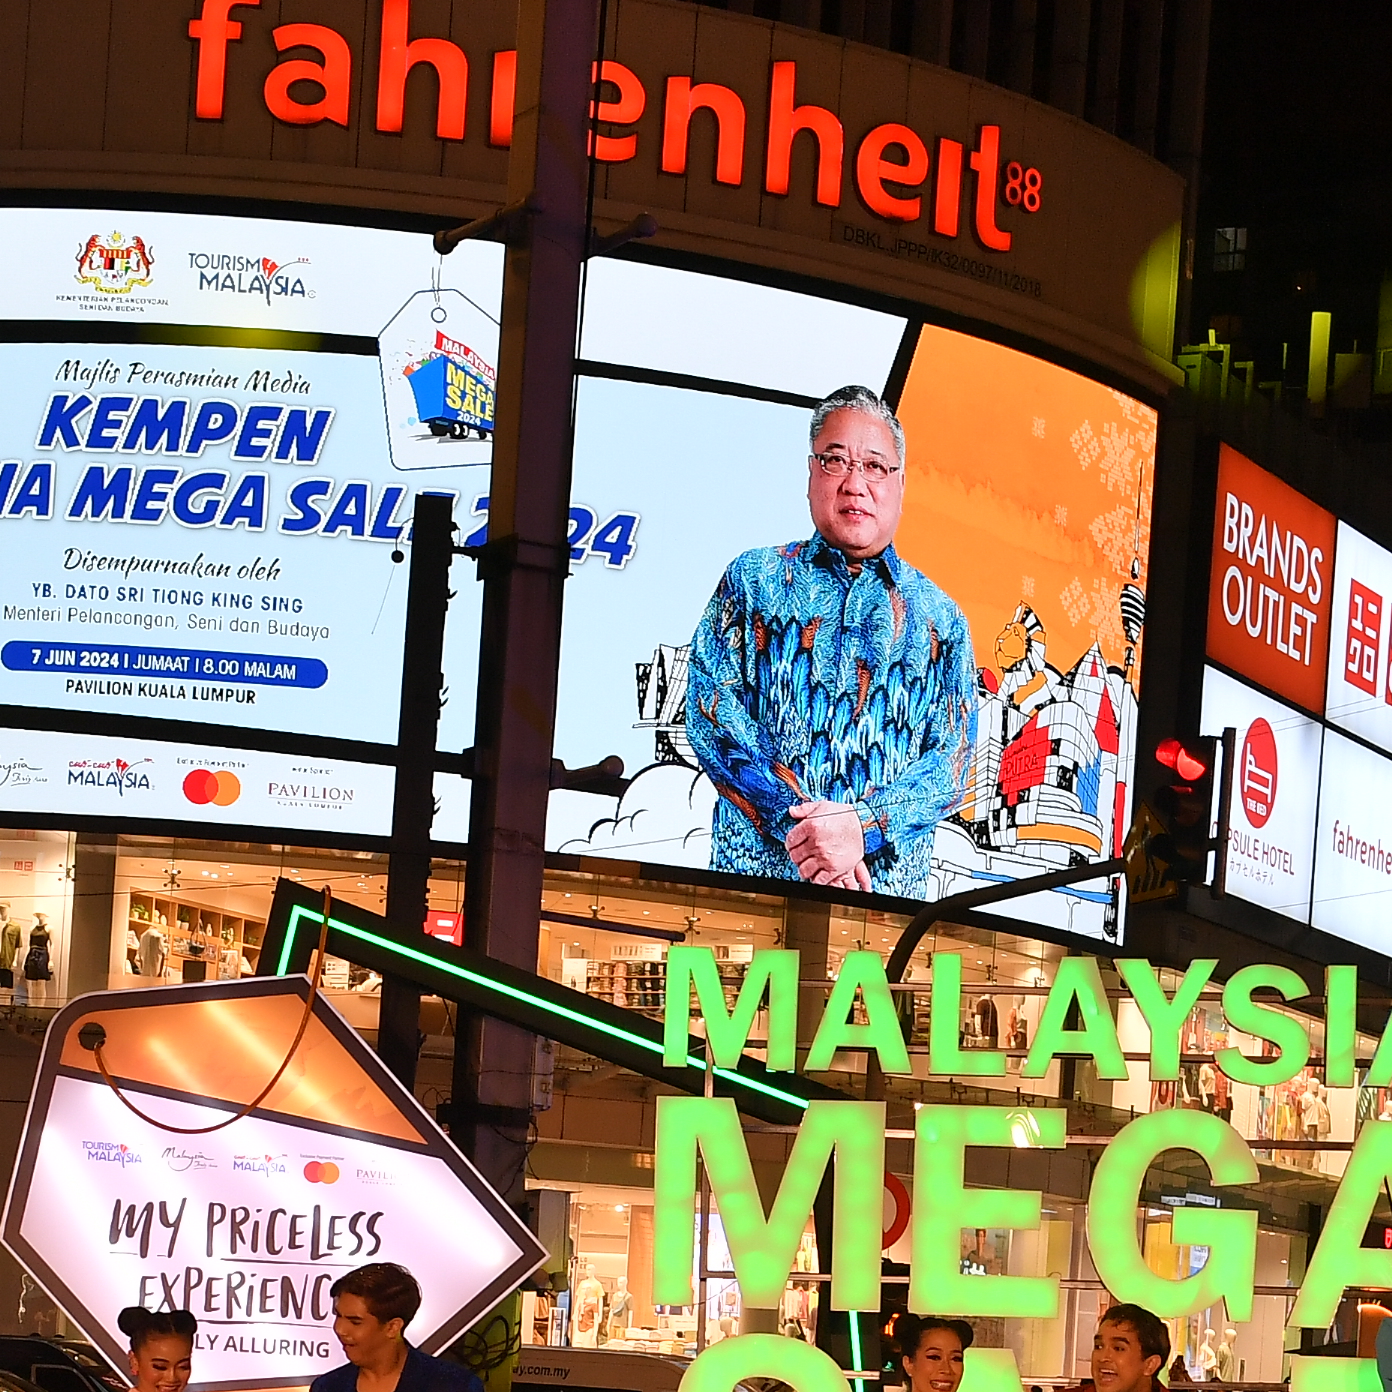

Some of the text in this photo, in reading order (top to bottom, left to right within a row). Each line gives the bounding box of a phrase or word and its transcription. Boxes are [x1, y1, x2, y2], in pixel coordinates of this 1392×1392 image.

[1004, 161, 1041, 213] 88
[188, 252, 260, 272] TOURISM
[199, 270, 306, 306] MALAYSIA
[55, 358, 311, 395] Majlis Perasmian Media
[445, 385, 494, 422] SALE
[457, 411, 482, 426] 2024
[37, 392, 334, 464] KEMPEN
[68, 464, 268, 531] MEGA
[280, 478, 459, 546] SAL
[465, 493, 640, 569] 224
[63, 547, 281, 582] Disempurnakan oleh
[1222, 491, 1324, 604] BRANDS
[31, 582, 304, 614] YB. DATO SRI TIONG KING SING
[3, 604, 331, 642] Menteri Pelancongan, Seni dan Budaya
[1221, 566, 1318, 667] OUTLET
[31, 649, 297, 681] 7 JUN 2024 JUMAAT 8.00 MALAM
[65, 678, 257, 705] PAVILION KUALA LUMPUR
[67, 769, 150, 797] MALAYSIA
[268, 782, 354, 801] PAVILION
[1261, 841, 1295, 876] HOTEL
[82, 1141, 120, 1151] TOURISM
[88, 1150, 142, 1168] MALAYSIA
[233, 1160, 286, 1178] MALAYSIA
[109, 1197, 187, 1259] MY
[222, 1334, 331, 1360] ALLURING
